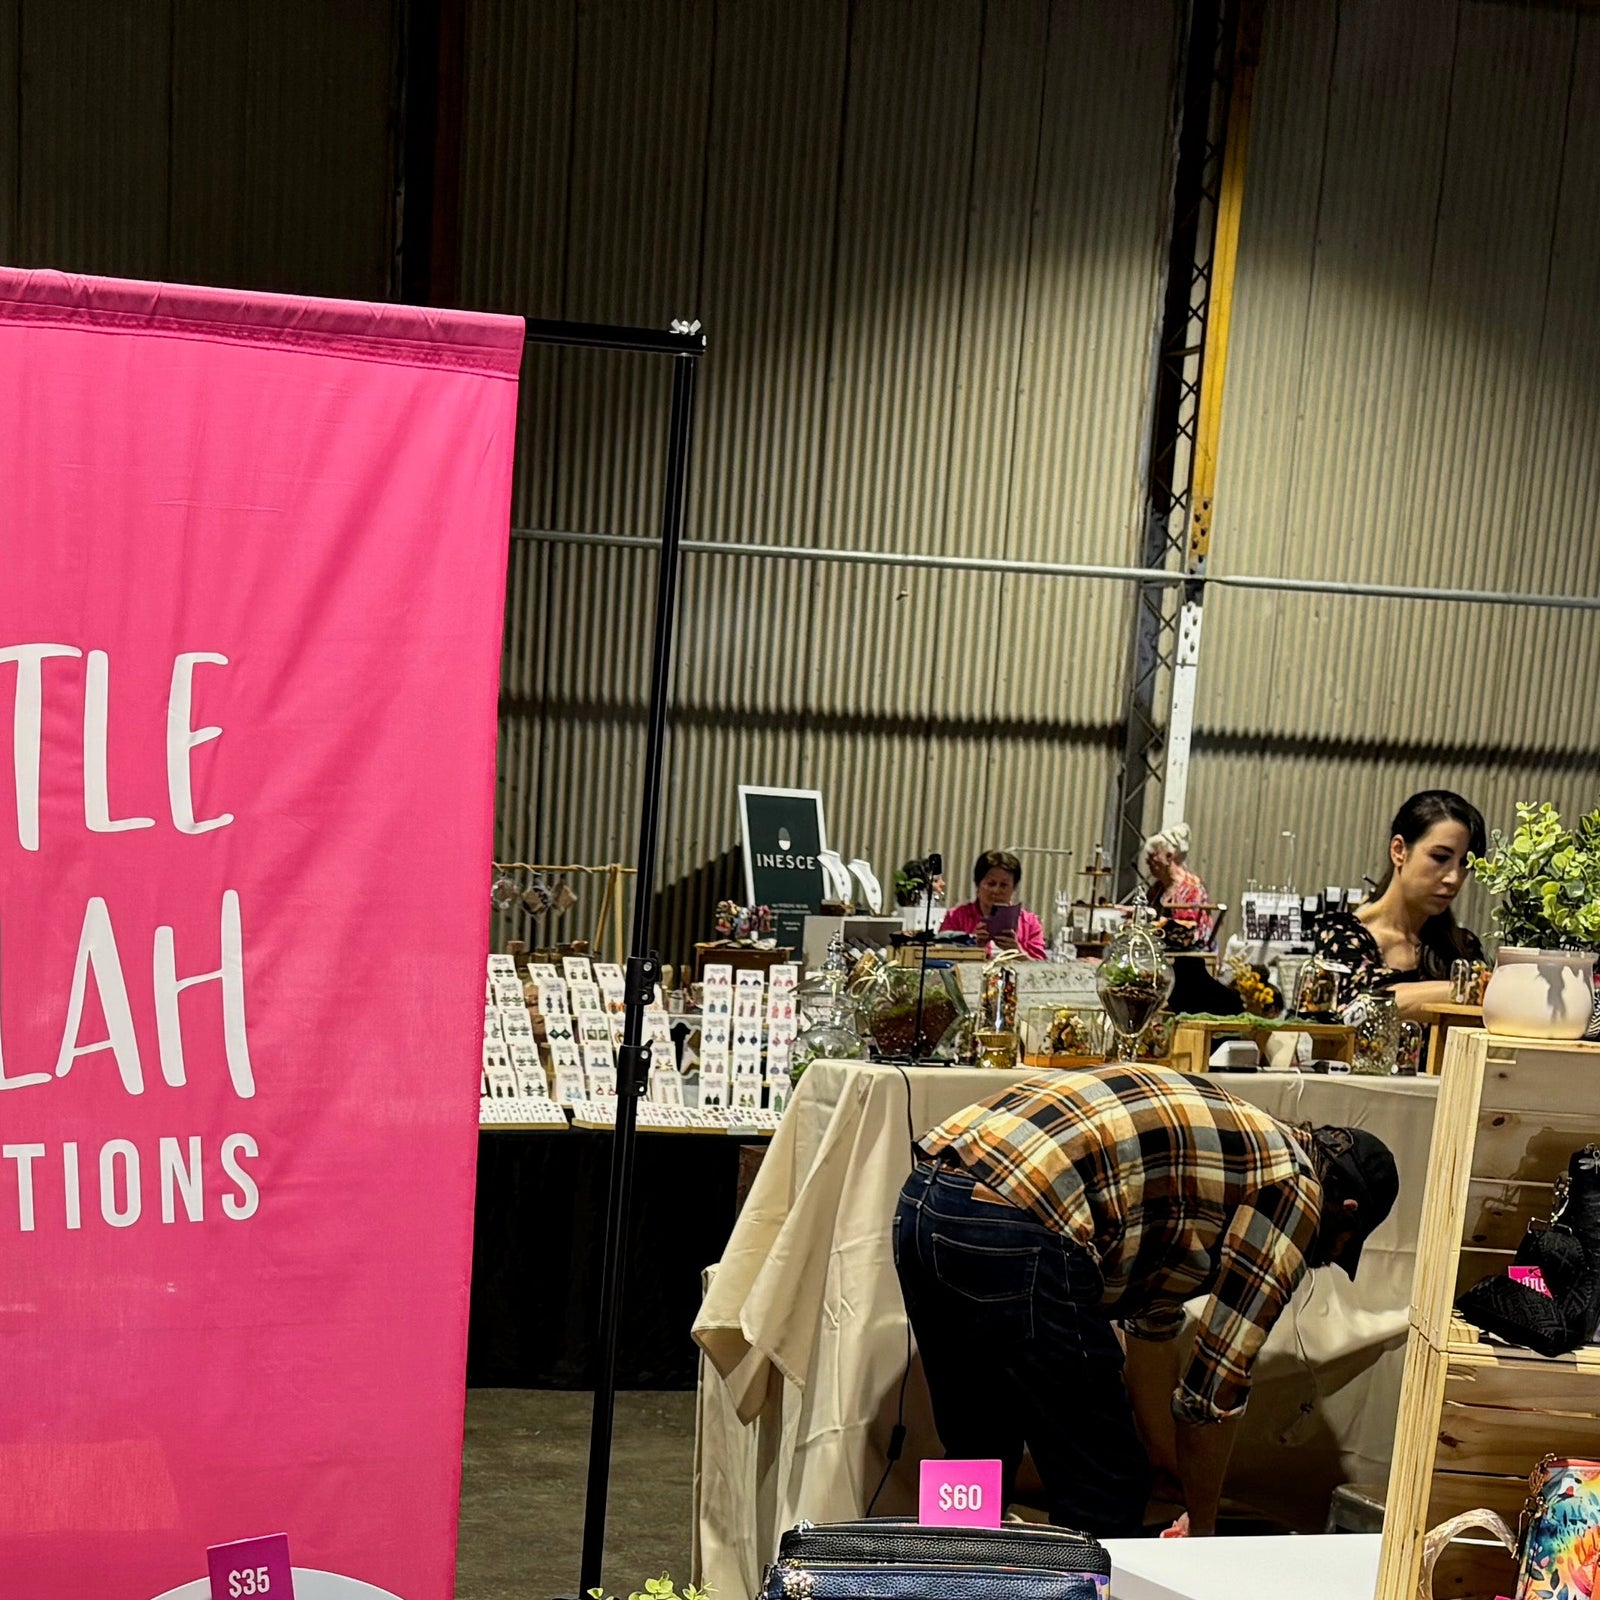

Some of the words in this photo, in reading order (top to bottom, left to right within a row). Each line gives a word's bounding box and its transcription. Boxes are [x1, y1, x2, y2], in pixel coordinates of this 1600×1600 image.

[756, 853, 816, 870] INESCE
[938, 1482, 982, 1511] $60
[228, 1566, 270, 1598] $35
